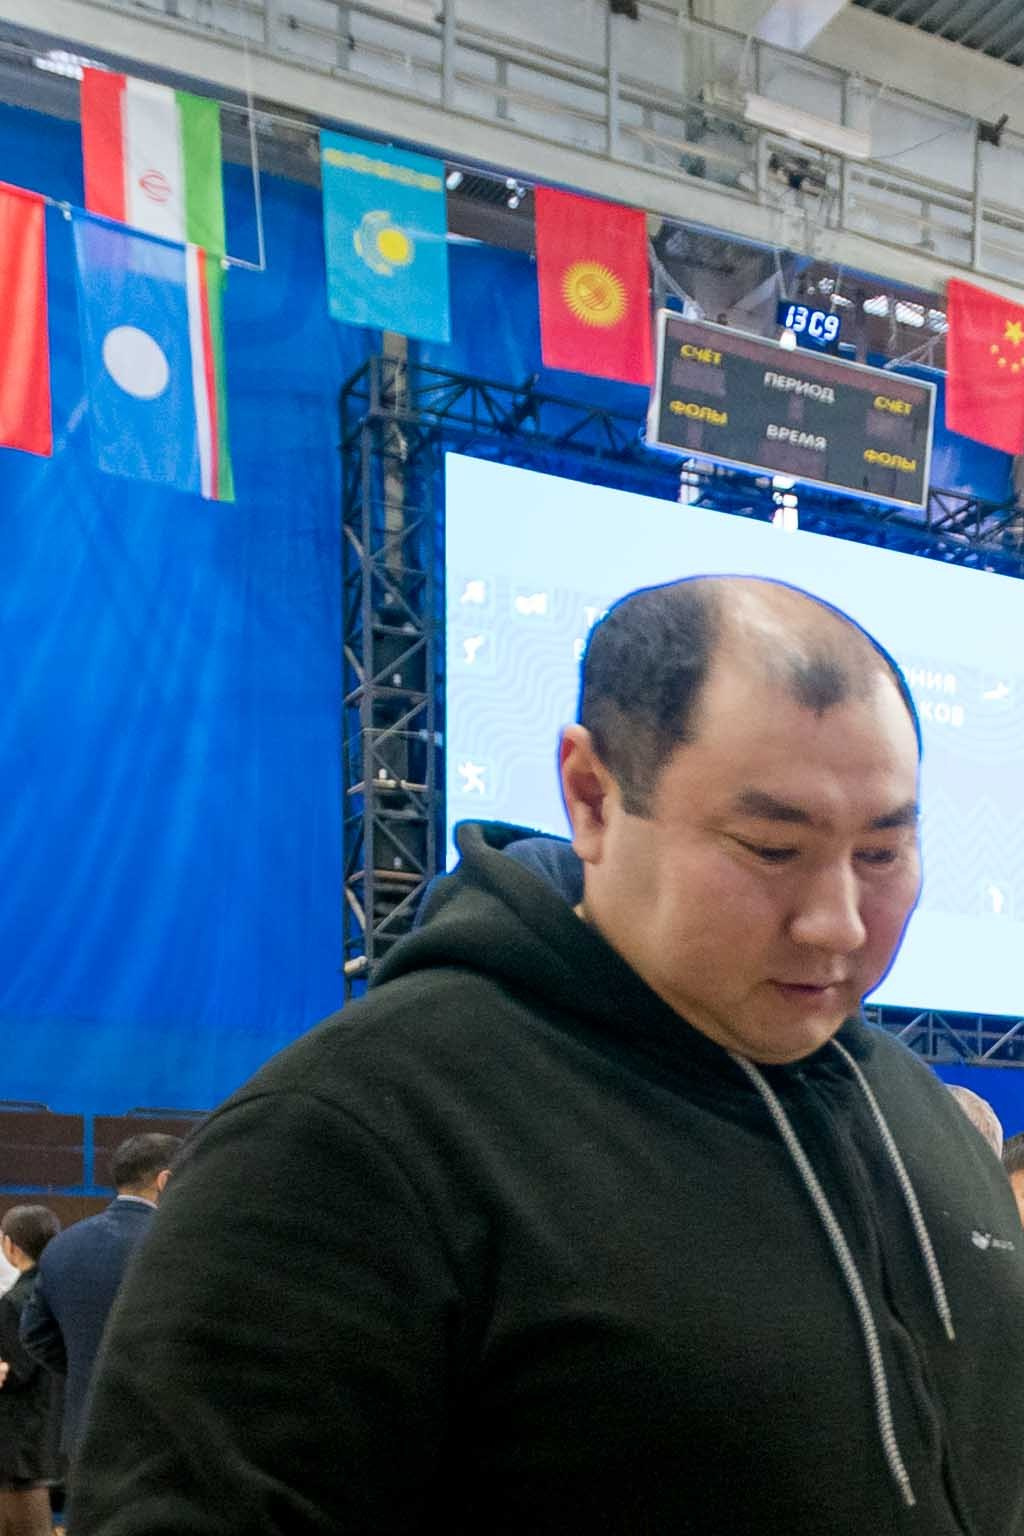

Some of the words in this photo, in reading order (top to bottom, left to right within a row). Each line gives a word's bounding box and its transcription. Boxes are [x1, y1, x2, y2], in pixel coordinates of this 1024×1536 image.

[763, 371, 835, 404] ПЕРИОД
[669, 400, 728, 426] ФОЛЫ
[766, 424, 827, 451] ВРЕМЯ
[863, 449, 917, 473] ФОЛЫ
